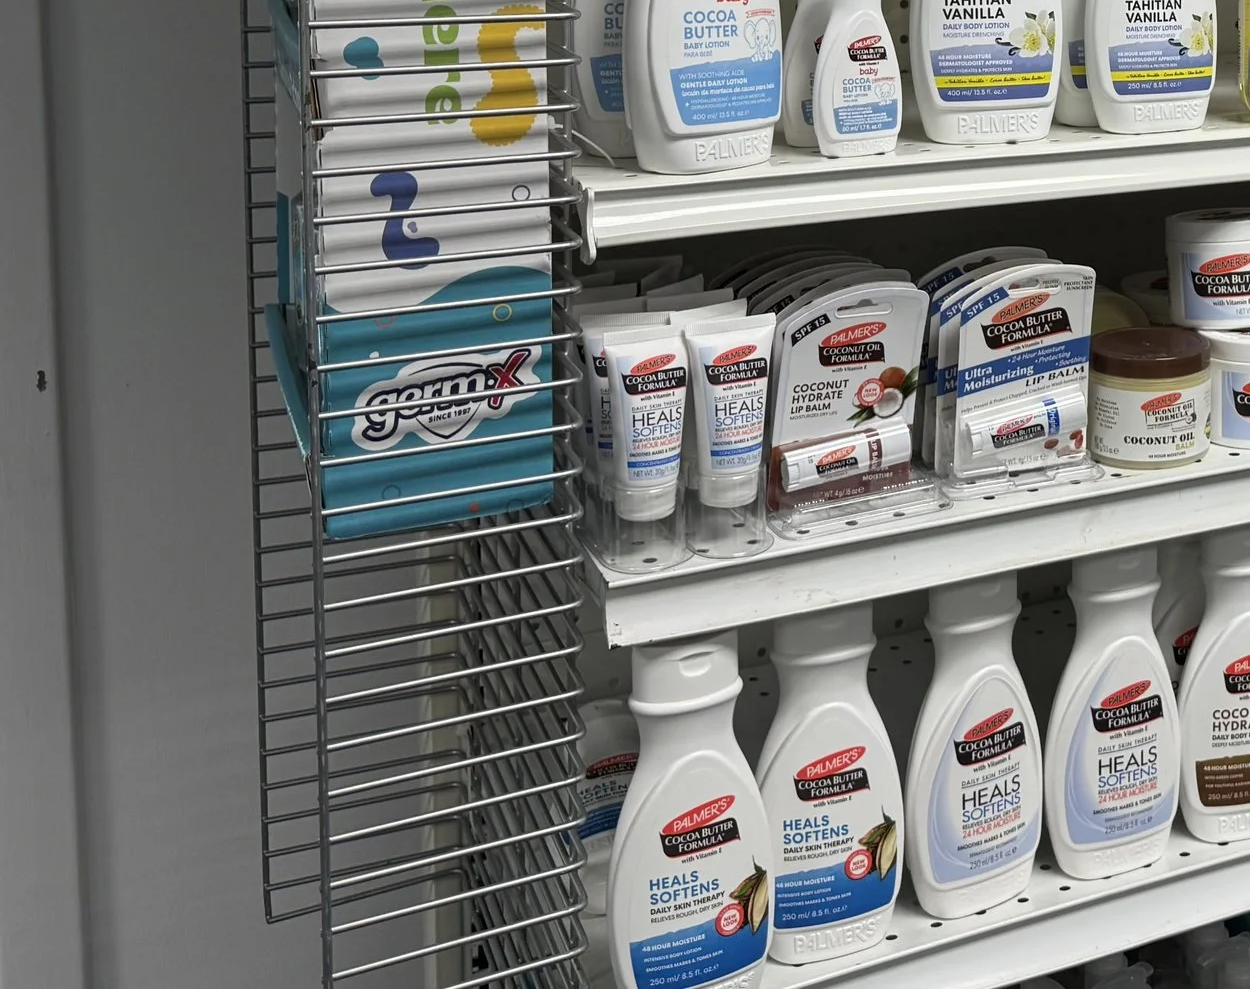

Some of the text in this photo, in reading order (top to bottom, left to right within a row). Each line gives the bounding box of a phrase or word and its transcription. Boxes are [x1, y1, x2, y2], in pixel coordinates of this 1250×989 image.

[943, 8, 1005, 20] VANILLA
[1126, 0, 1182, 10] TAHITIAN
[684, 10, 736, 23] COCOA
[1126, 13, 1177, 23] VANILLA
[684, 25, 738, 39] BUTTER
[684, 42, 702, 50] BABY
[860, 67, 878, 76] baby
[1195, 275, 1230, 285] COCOA
[967, 293, 1000, 318] SPF 15
[1000, 295, 1044, 320] PALMER'S
[795, 317, 825, 341] SPF 15
[987, 311, 1063, 337] COCOA BUTTER
[831, 325, 879, 344] PALMER'S
[1002, 325, 1050, 344] FORMULA
[823, 344, 880, 355] COCONUT OIL
[831, 353, 870, 363] FORMULA
[626, 370, 684, 385] COCOA BUTTER
[964, 365, 1034, 392] Moisturizing
[965, 366, 992, 380] Ultra
[1026, 366, 1084, 386] LIP BALM
[794, 379, 849, 393] COCONUT
[715, 397, 763, 417] HEALS
[792, 391, 843, 404] HYDRATE
[633, 407, 682, 428] HEALS
[791, 403, 830, 414] LIP BALM
[716, 412, 763, 427] SOFTENS
[633, 423, 681, 438] SOFTENS
[1124, 433, 1195, 445] COCONUT OIL
[807, 749, 858, 777] PALMER'S
[1099, 746, 1158, 775] HEALS
[1099, 763, 1158, 787] SOFTENS
[963, 775, 1020, 810] HEALS
[674, 798, 727, 832] PALMER'S
[963, 792, 1021, 822] SOFTENS
[783, 815, 830, 831] HEALS
[665, 821, 733, 846] COCOA BUTTER
[784, 824, 849, 844] SOFTENS
[650, 870, 699, 891] HEALS
[650, 878, 719, 905] SOFTENS
